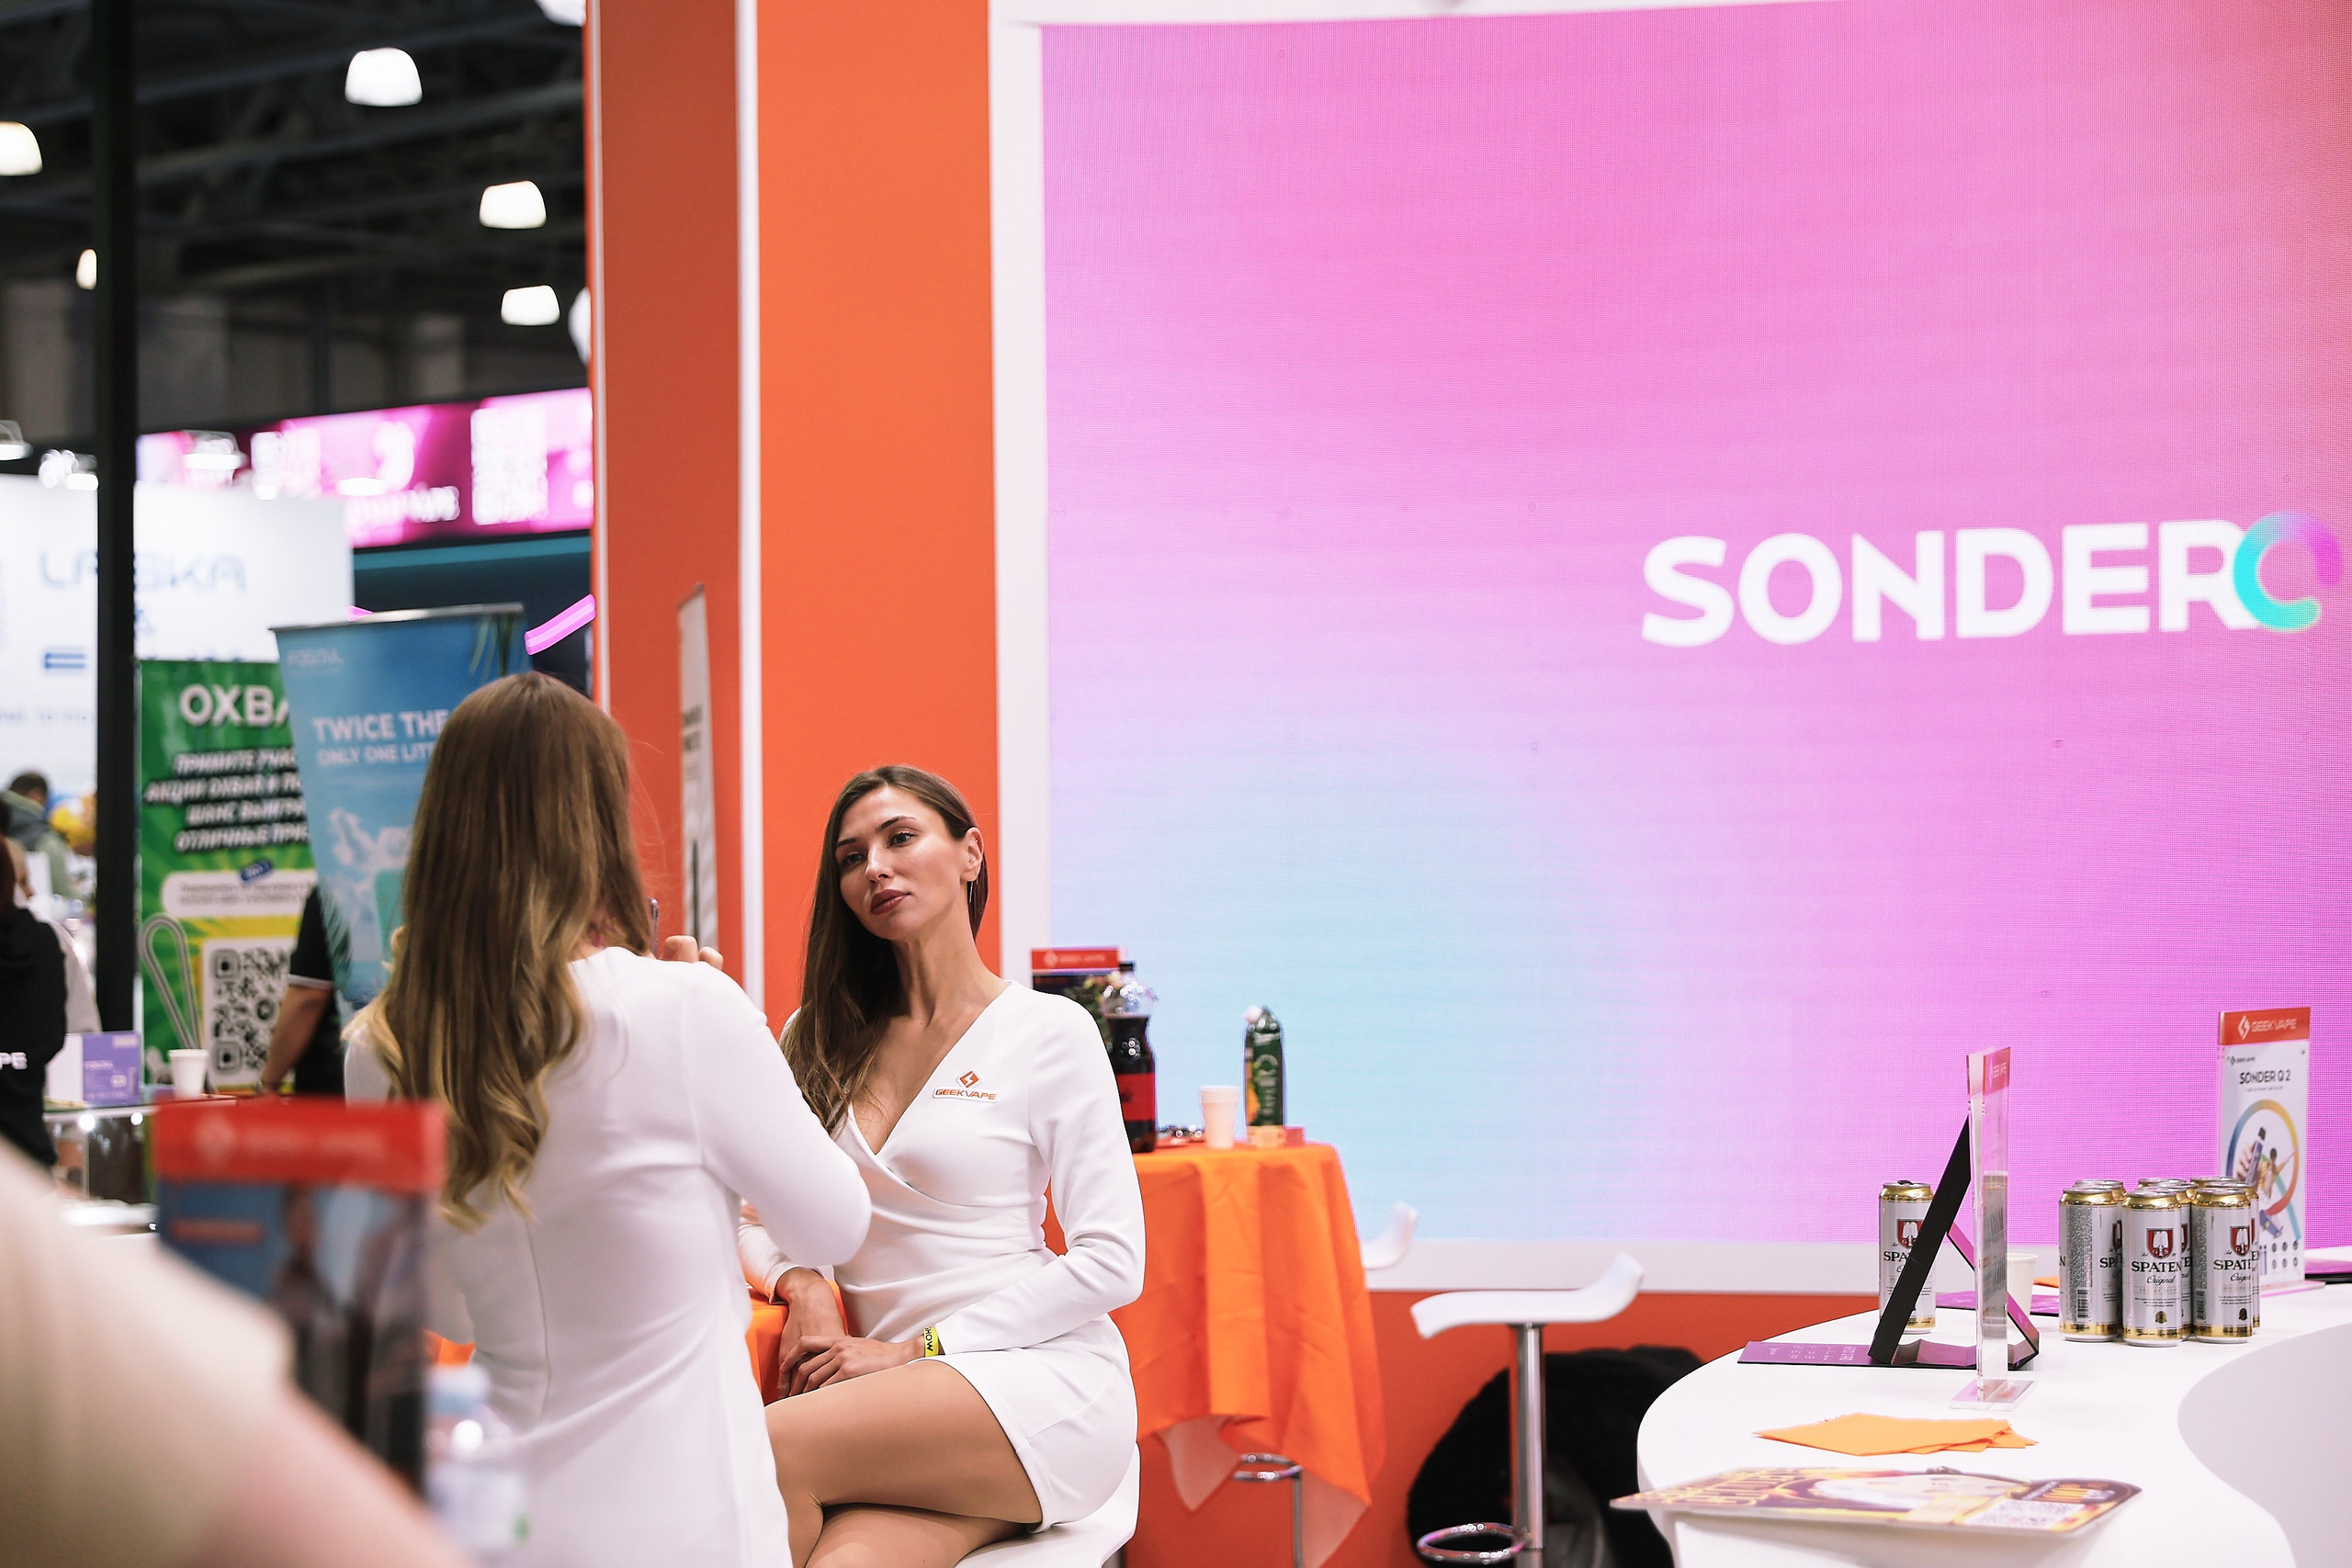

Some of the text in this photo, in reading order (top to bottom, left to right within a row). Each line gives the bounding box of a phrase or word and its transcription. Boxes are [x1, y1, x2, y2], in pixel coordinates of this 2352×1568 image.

[312, 713, 397, 742] TWICE
[365, 742, 399, 764] ONE
[2239, 1070, 2276, 1085] SONDER
[1883, 1251, 1911, 1262] SPA
[2131, 1260, 2182, 1273] SPATEN
[2146, 1273, 2177, 1286] Original
[924, 1327, 934, 1352] HOW
